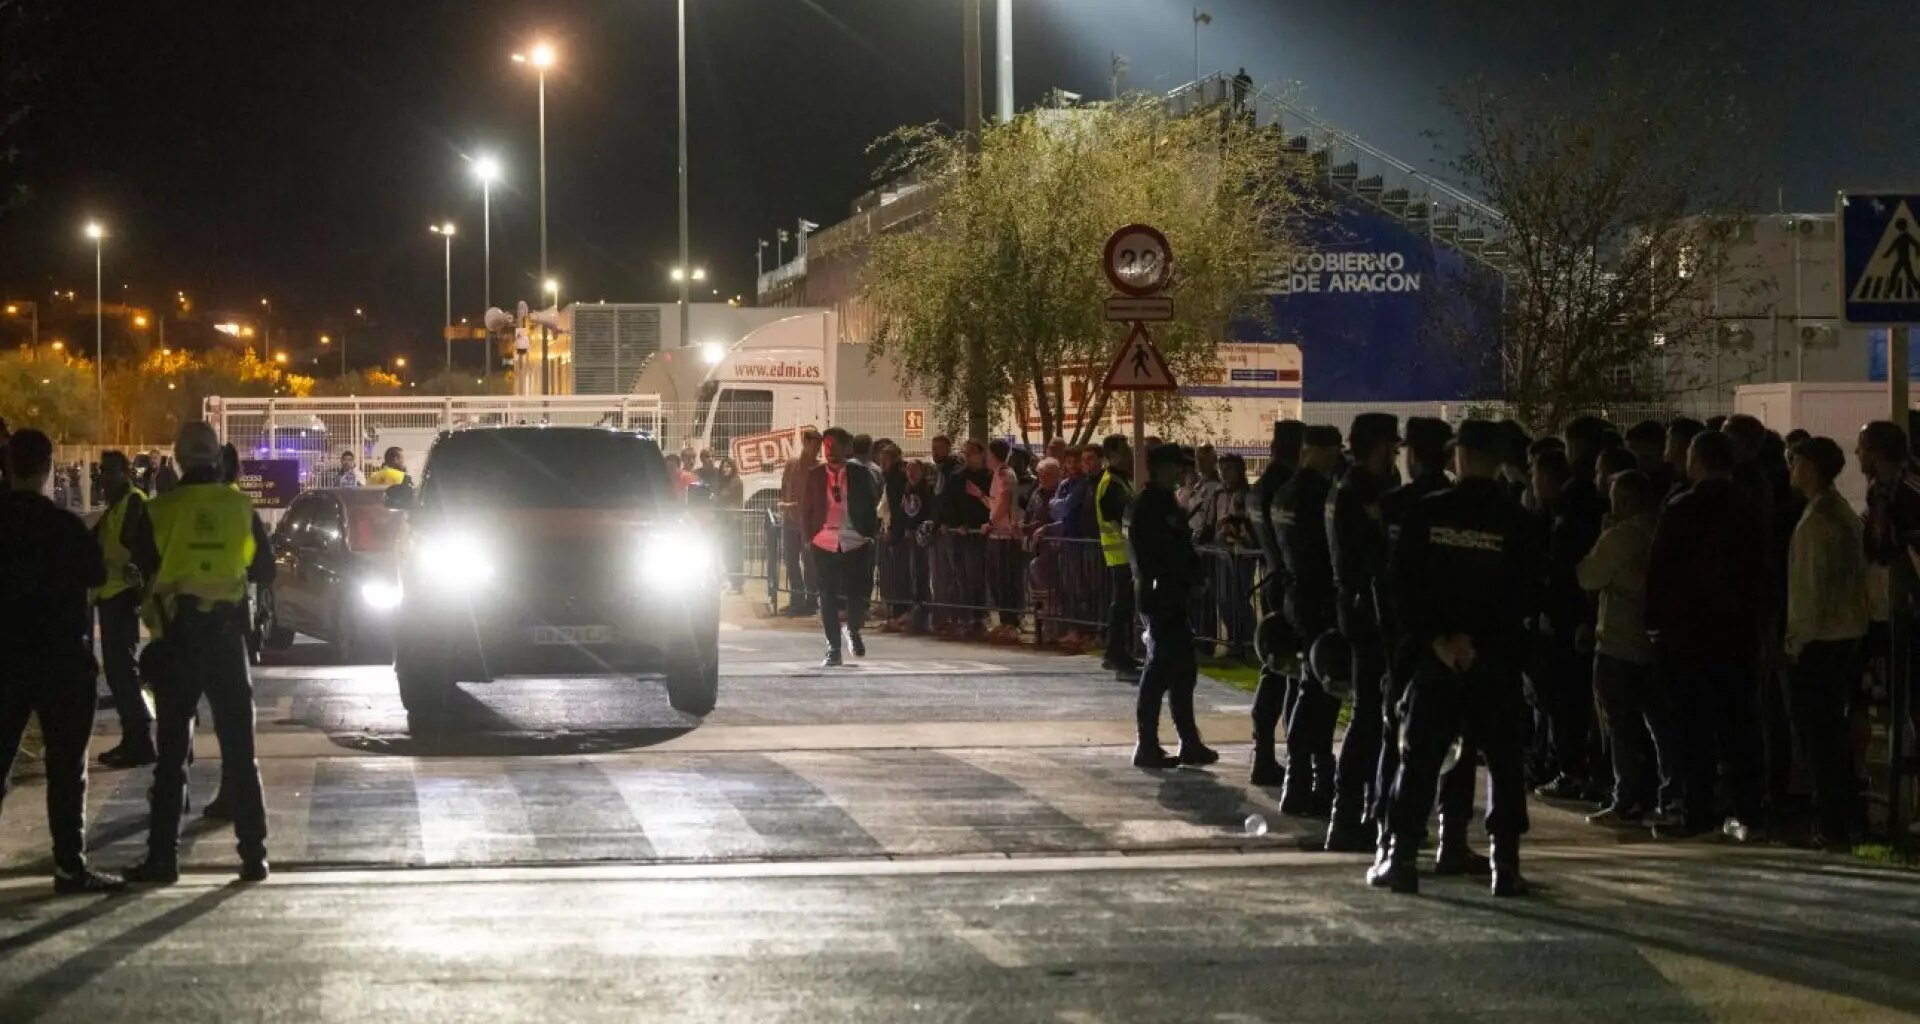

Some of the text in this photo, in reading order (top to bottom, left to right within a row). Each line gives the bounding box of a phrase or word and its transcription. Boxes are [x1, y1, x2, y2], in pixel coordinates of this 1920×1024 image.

[1292, 274, 1320, 292] DE
[735, 361, 820, 378] www.edmi.es
[740, 436, 804, 470] EDM
